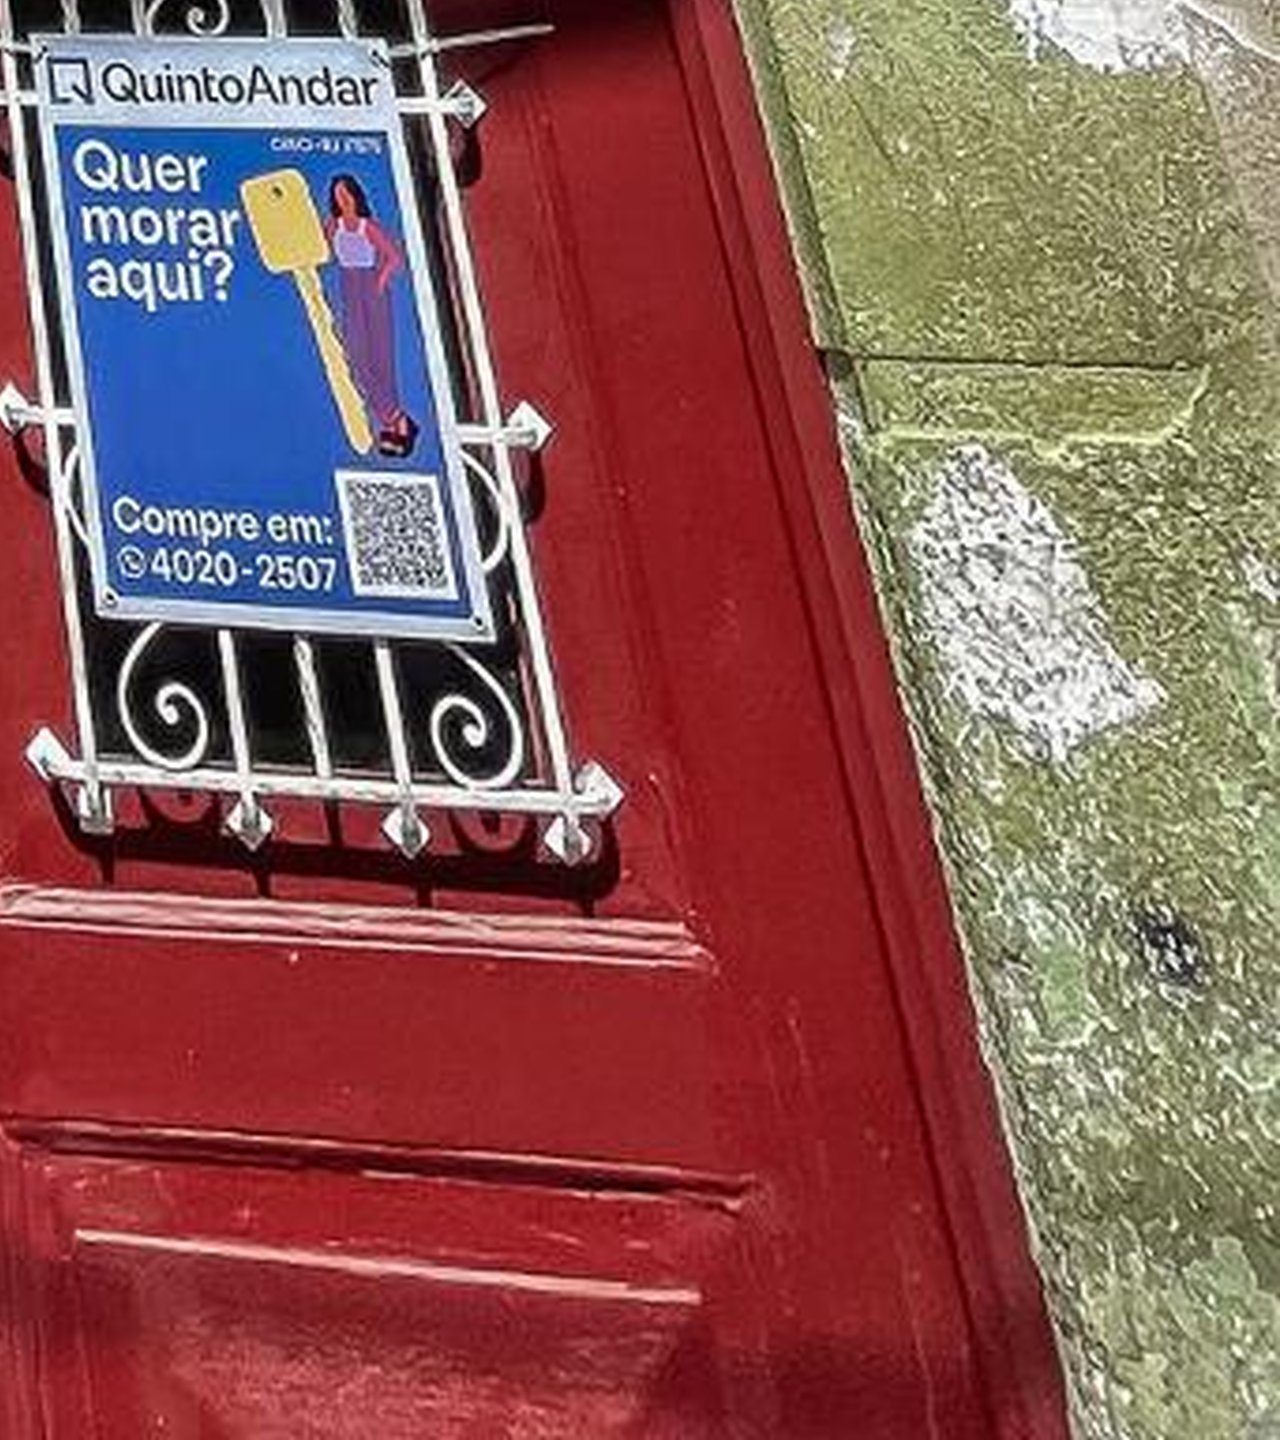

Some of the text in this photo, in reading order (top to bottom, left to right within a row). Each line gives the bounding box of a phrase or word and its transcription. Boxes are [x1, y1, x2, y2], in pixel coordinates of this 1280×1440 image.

[101, 62, 379, 107] QuintoAndar
[73, 139, 208, 192] Quer
[81, 206, 240, 247] morar
[87, 249, 235, 312] aqui?
[113, 496, 333, 547] Compre em:
[150, 547, 337, 591] 4020-2507
